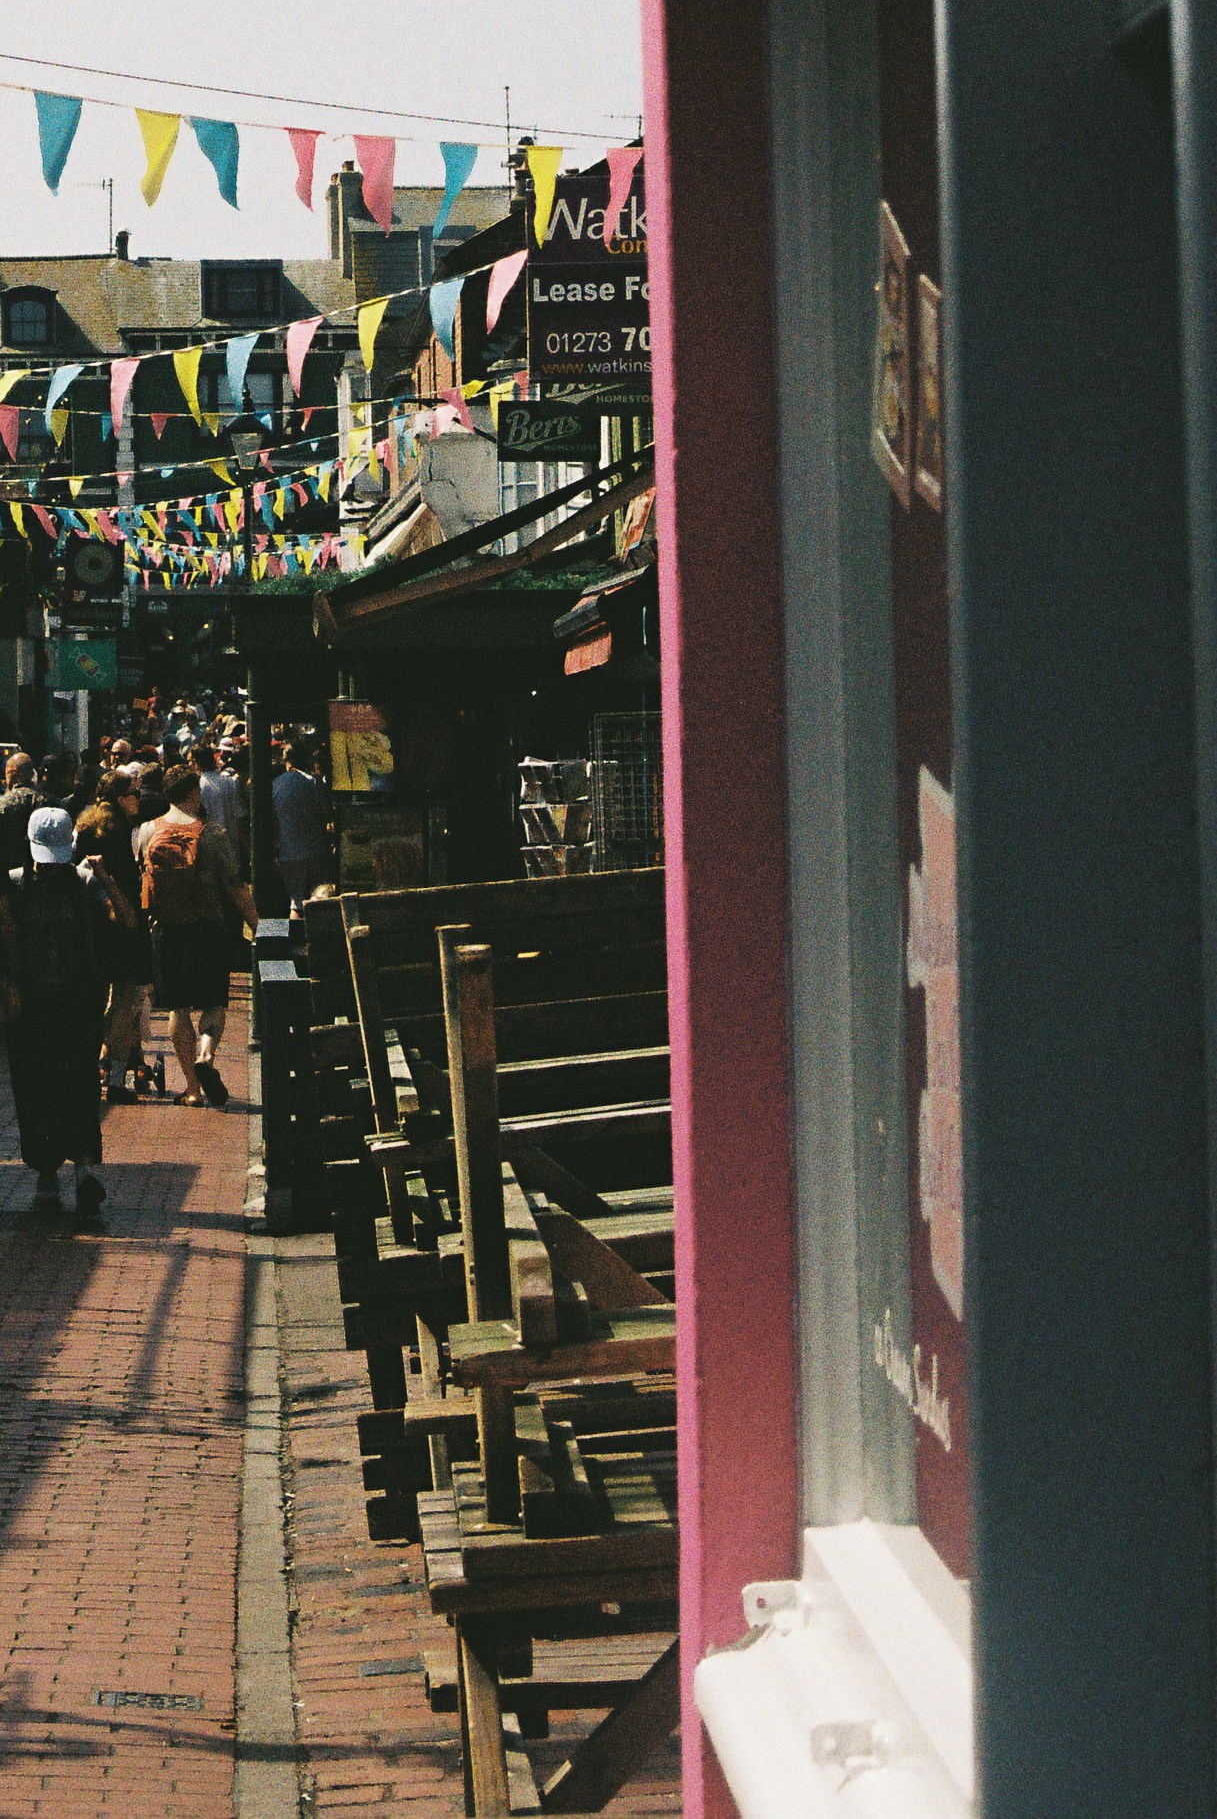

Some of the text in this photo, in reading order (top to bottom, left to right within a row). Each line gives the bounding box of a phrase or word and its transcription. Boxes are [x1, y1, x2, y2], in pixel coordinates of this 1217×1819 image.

[533, 277, 616, 302] Lease
[546, 326, 652, 354] 01273 70
[542, 358, 652, 374] www.watkins
